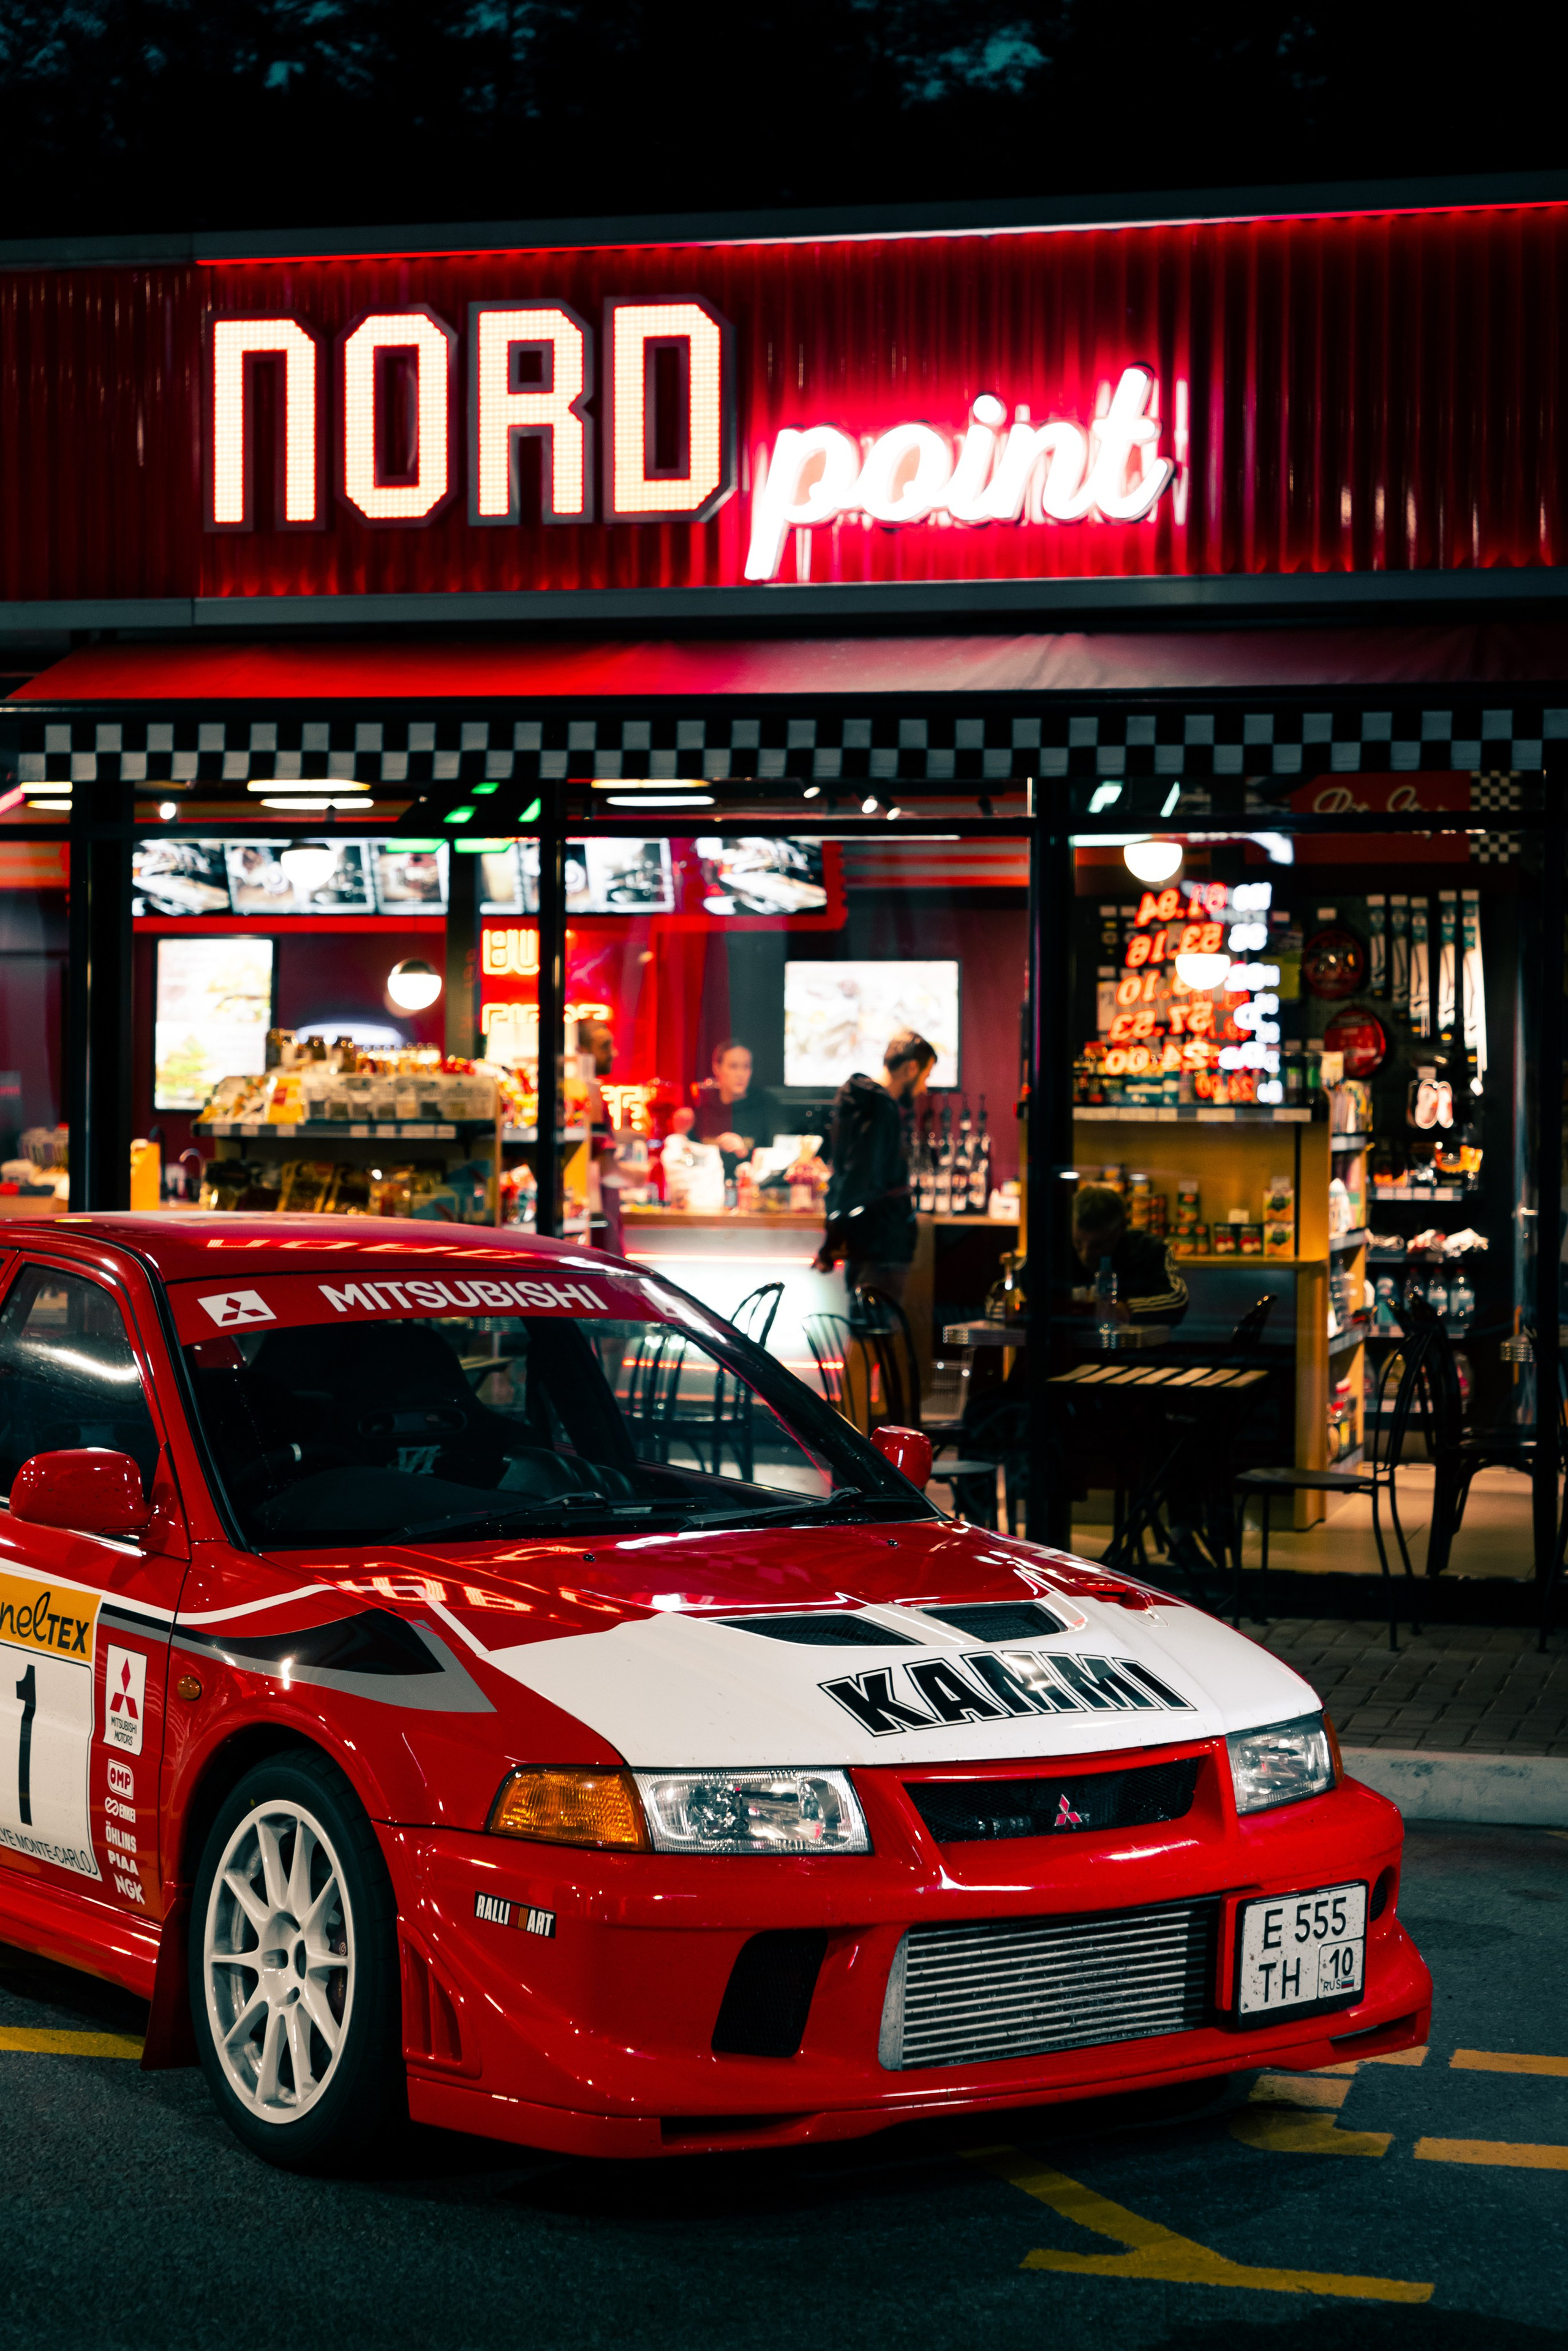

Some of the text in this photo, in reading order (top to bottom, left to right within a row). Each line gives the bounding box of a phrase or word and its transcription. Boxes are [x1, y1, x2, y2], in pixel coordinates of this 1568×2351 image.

[746, 363, 1174, 581] point
[318, 1281, 609, 1313] MITSUBISHI
[818, 1650, 1197, 1737] KAMMI
[110, 1716, 137, 1735] MITSUBISHI
[114, 1730, 134, 1746] MOTORS
[16, 1664, 36, 1827] 1
[110, 1767, 131, 1790] OMP
[15, 1833, 91, 1873] MONTE-CARLO
[105, 1820, 137, 1854] ÖHLINS
[107, 1849, 140, 1876] PIAA
[113, 1873, 145, 1906] NGK
[1264, 1896, 1346, 1949] E 555
[1259, 1947, 1353, 2002] TH 10
[1323, 1979, 1341, 1991] RUS
